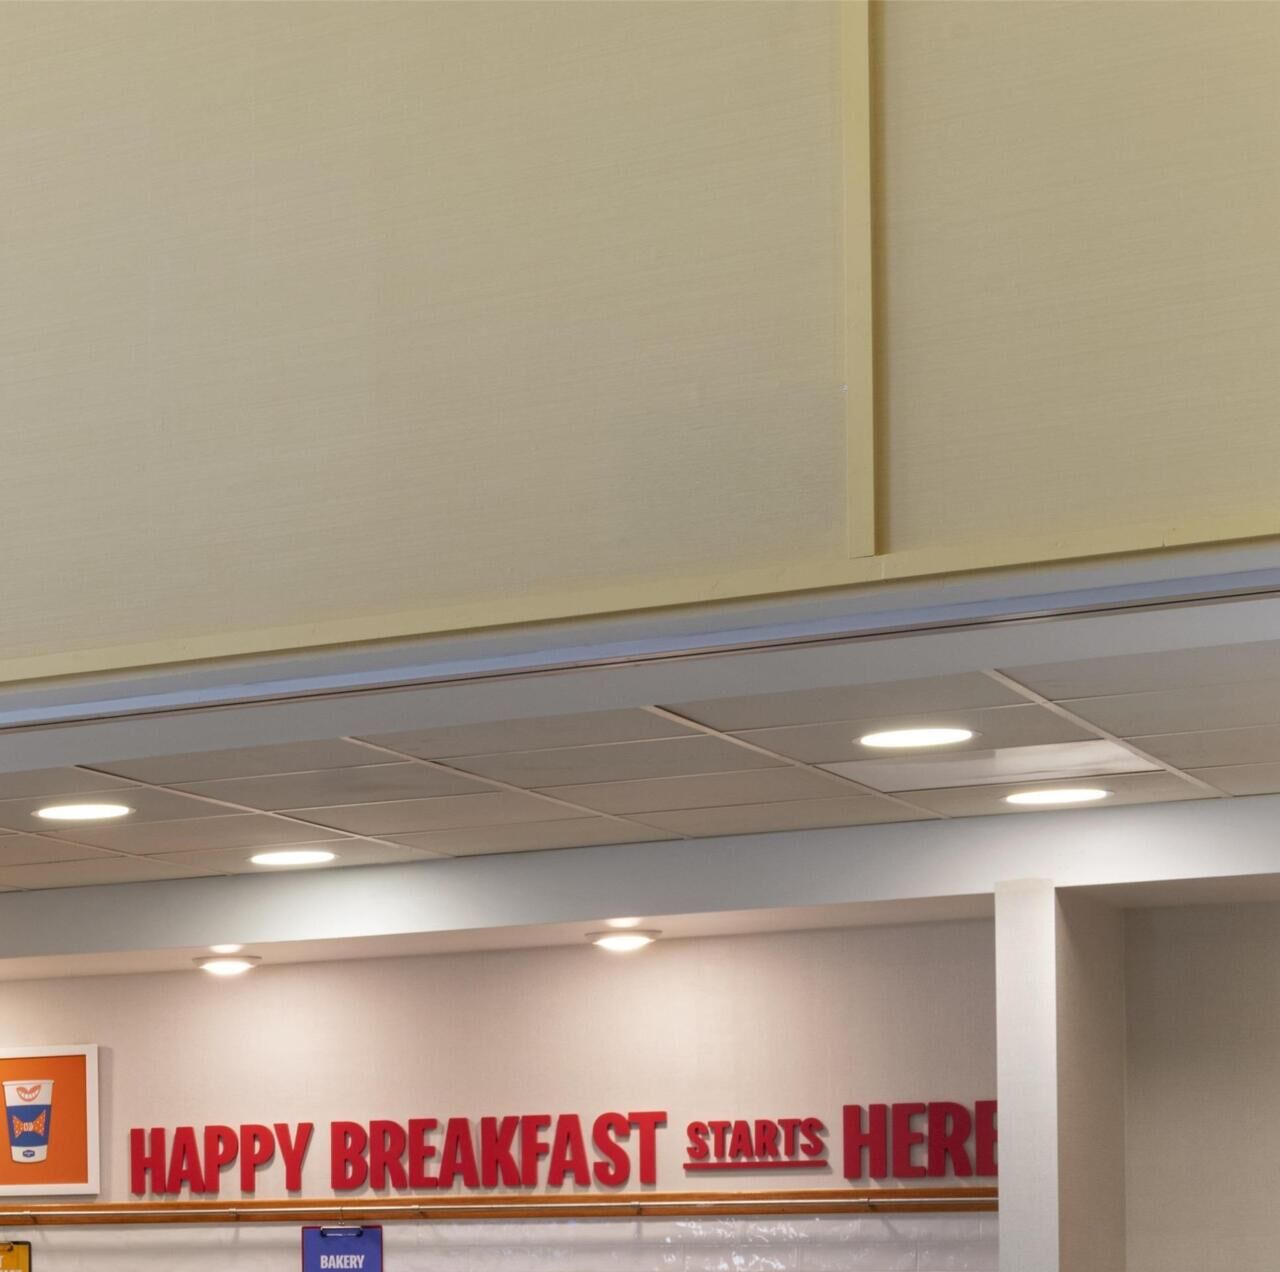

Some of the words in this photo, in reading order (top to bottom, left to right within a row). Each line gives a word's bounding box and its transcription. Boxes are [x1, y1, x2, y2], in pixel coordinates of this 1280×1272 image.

[130, 1122, 313, 1194] HAPPY
[331, 1111, 667, 1190] BREAKFAST
[686, 1117, 827, 1161] STARTS
[843, 1101, 997, 1179] HERE
[320, 1254, 365, 1269] BAKERY
